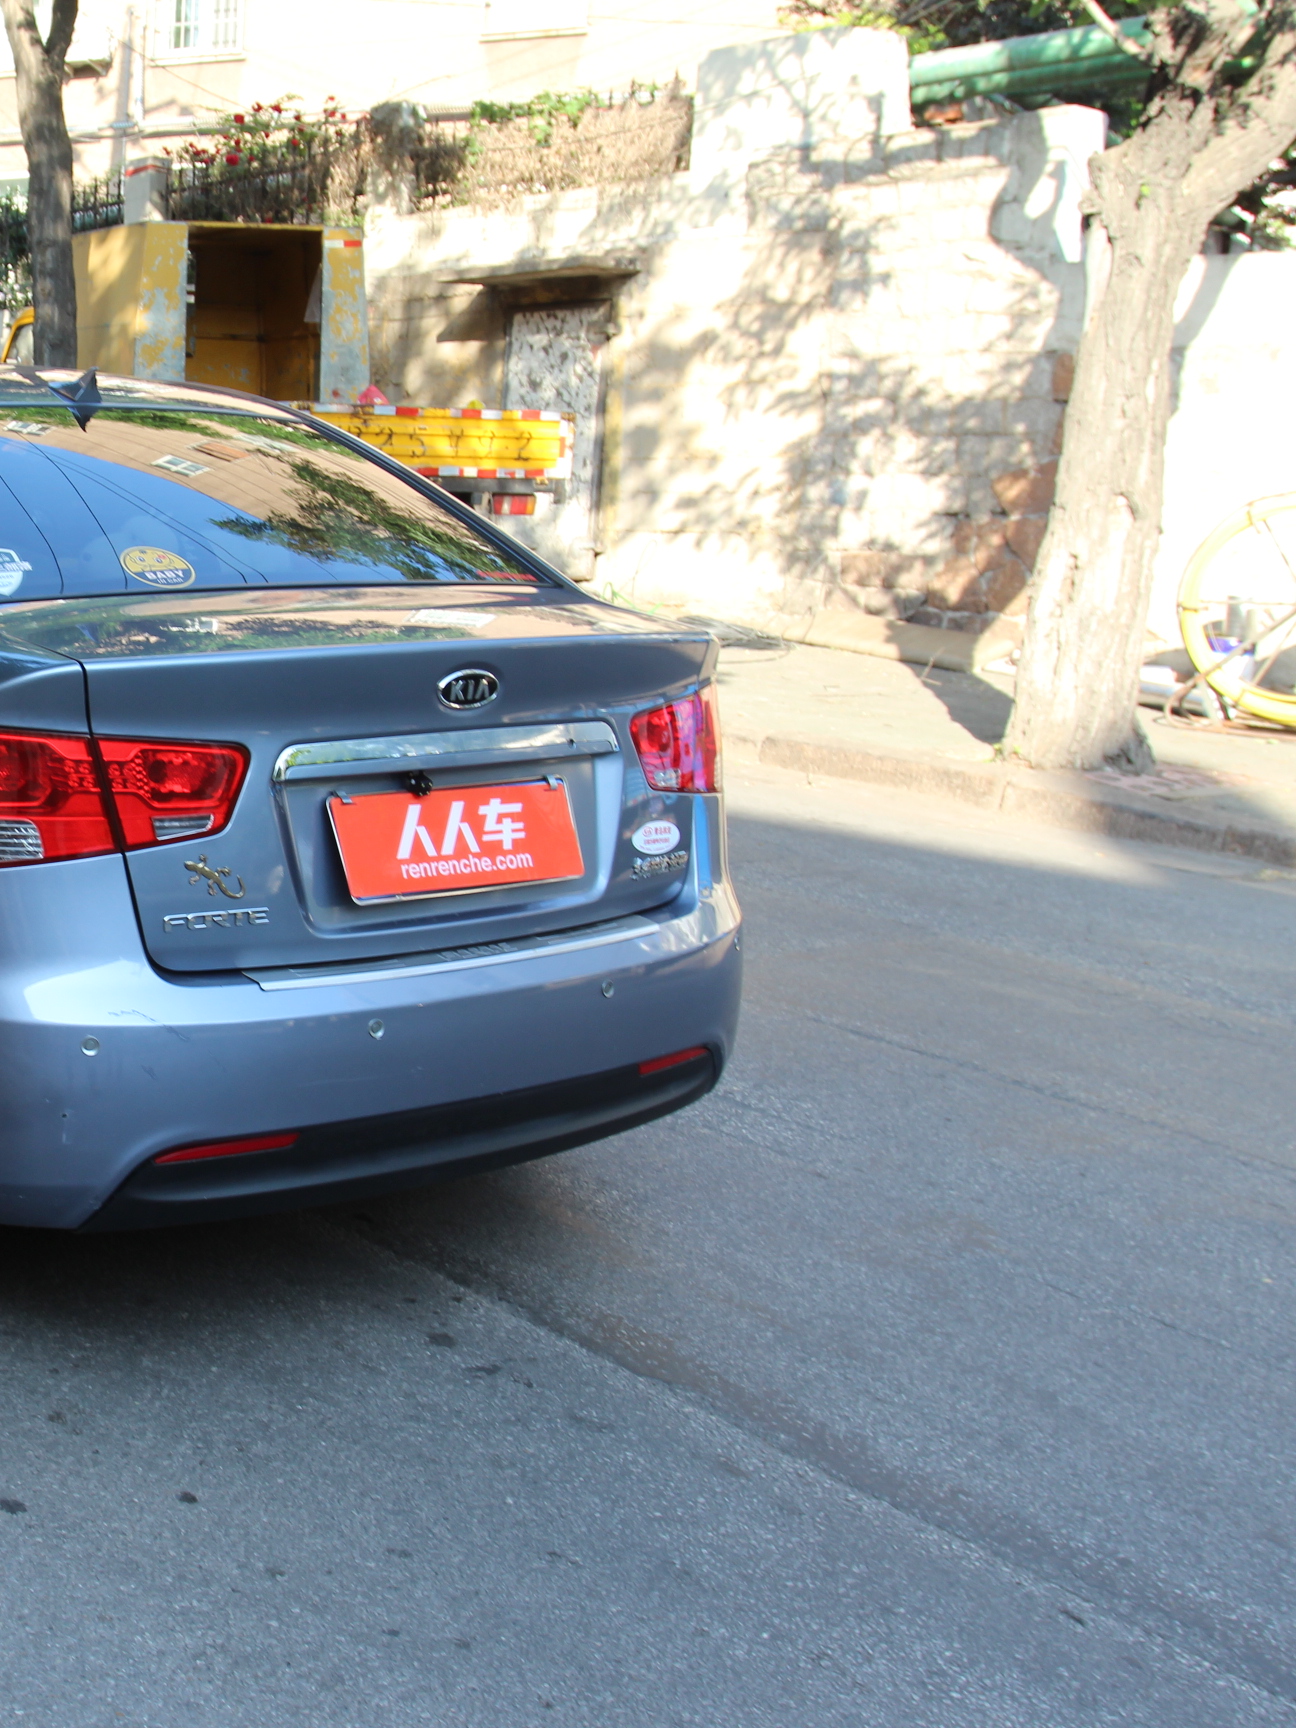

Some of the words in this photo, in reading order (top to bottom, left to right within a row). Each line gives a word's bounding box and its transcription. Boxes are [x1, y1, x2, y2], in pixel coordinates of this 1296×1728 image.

[144, 569, 184, 580] BABY
[450, 679, 490, 701] KIA
[396, 798, 526, 860] 人人车
[401, 853, 534, 879] renrenche.com
[163, 906, 270, 933] FORTE
